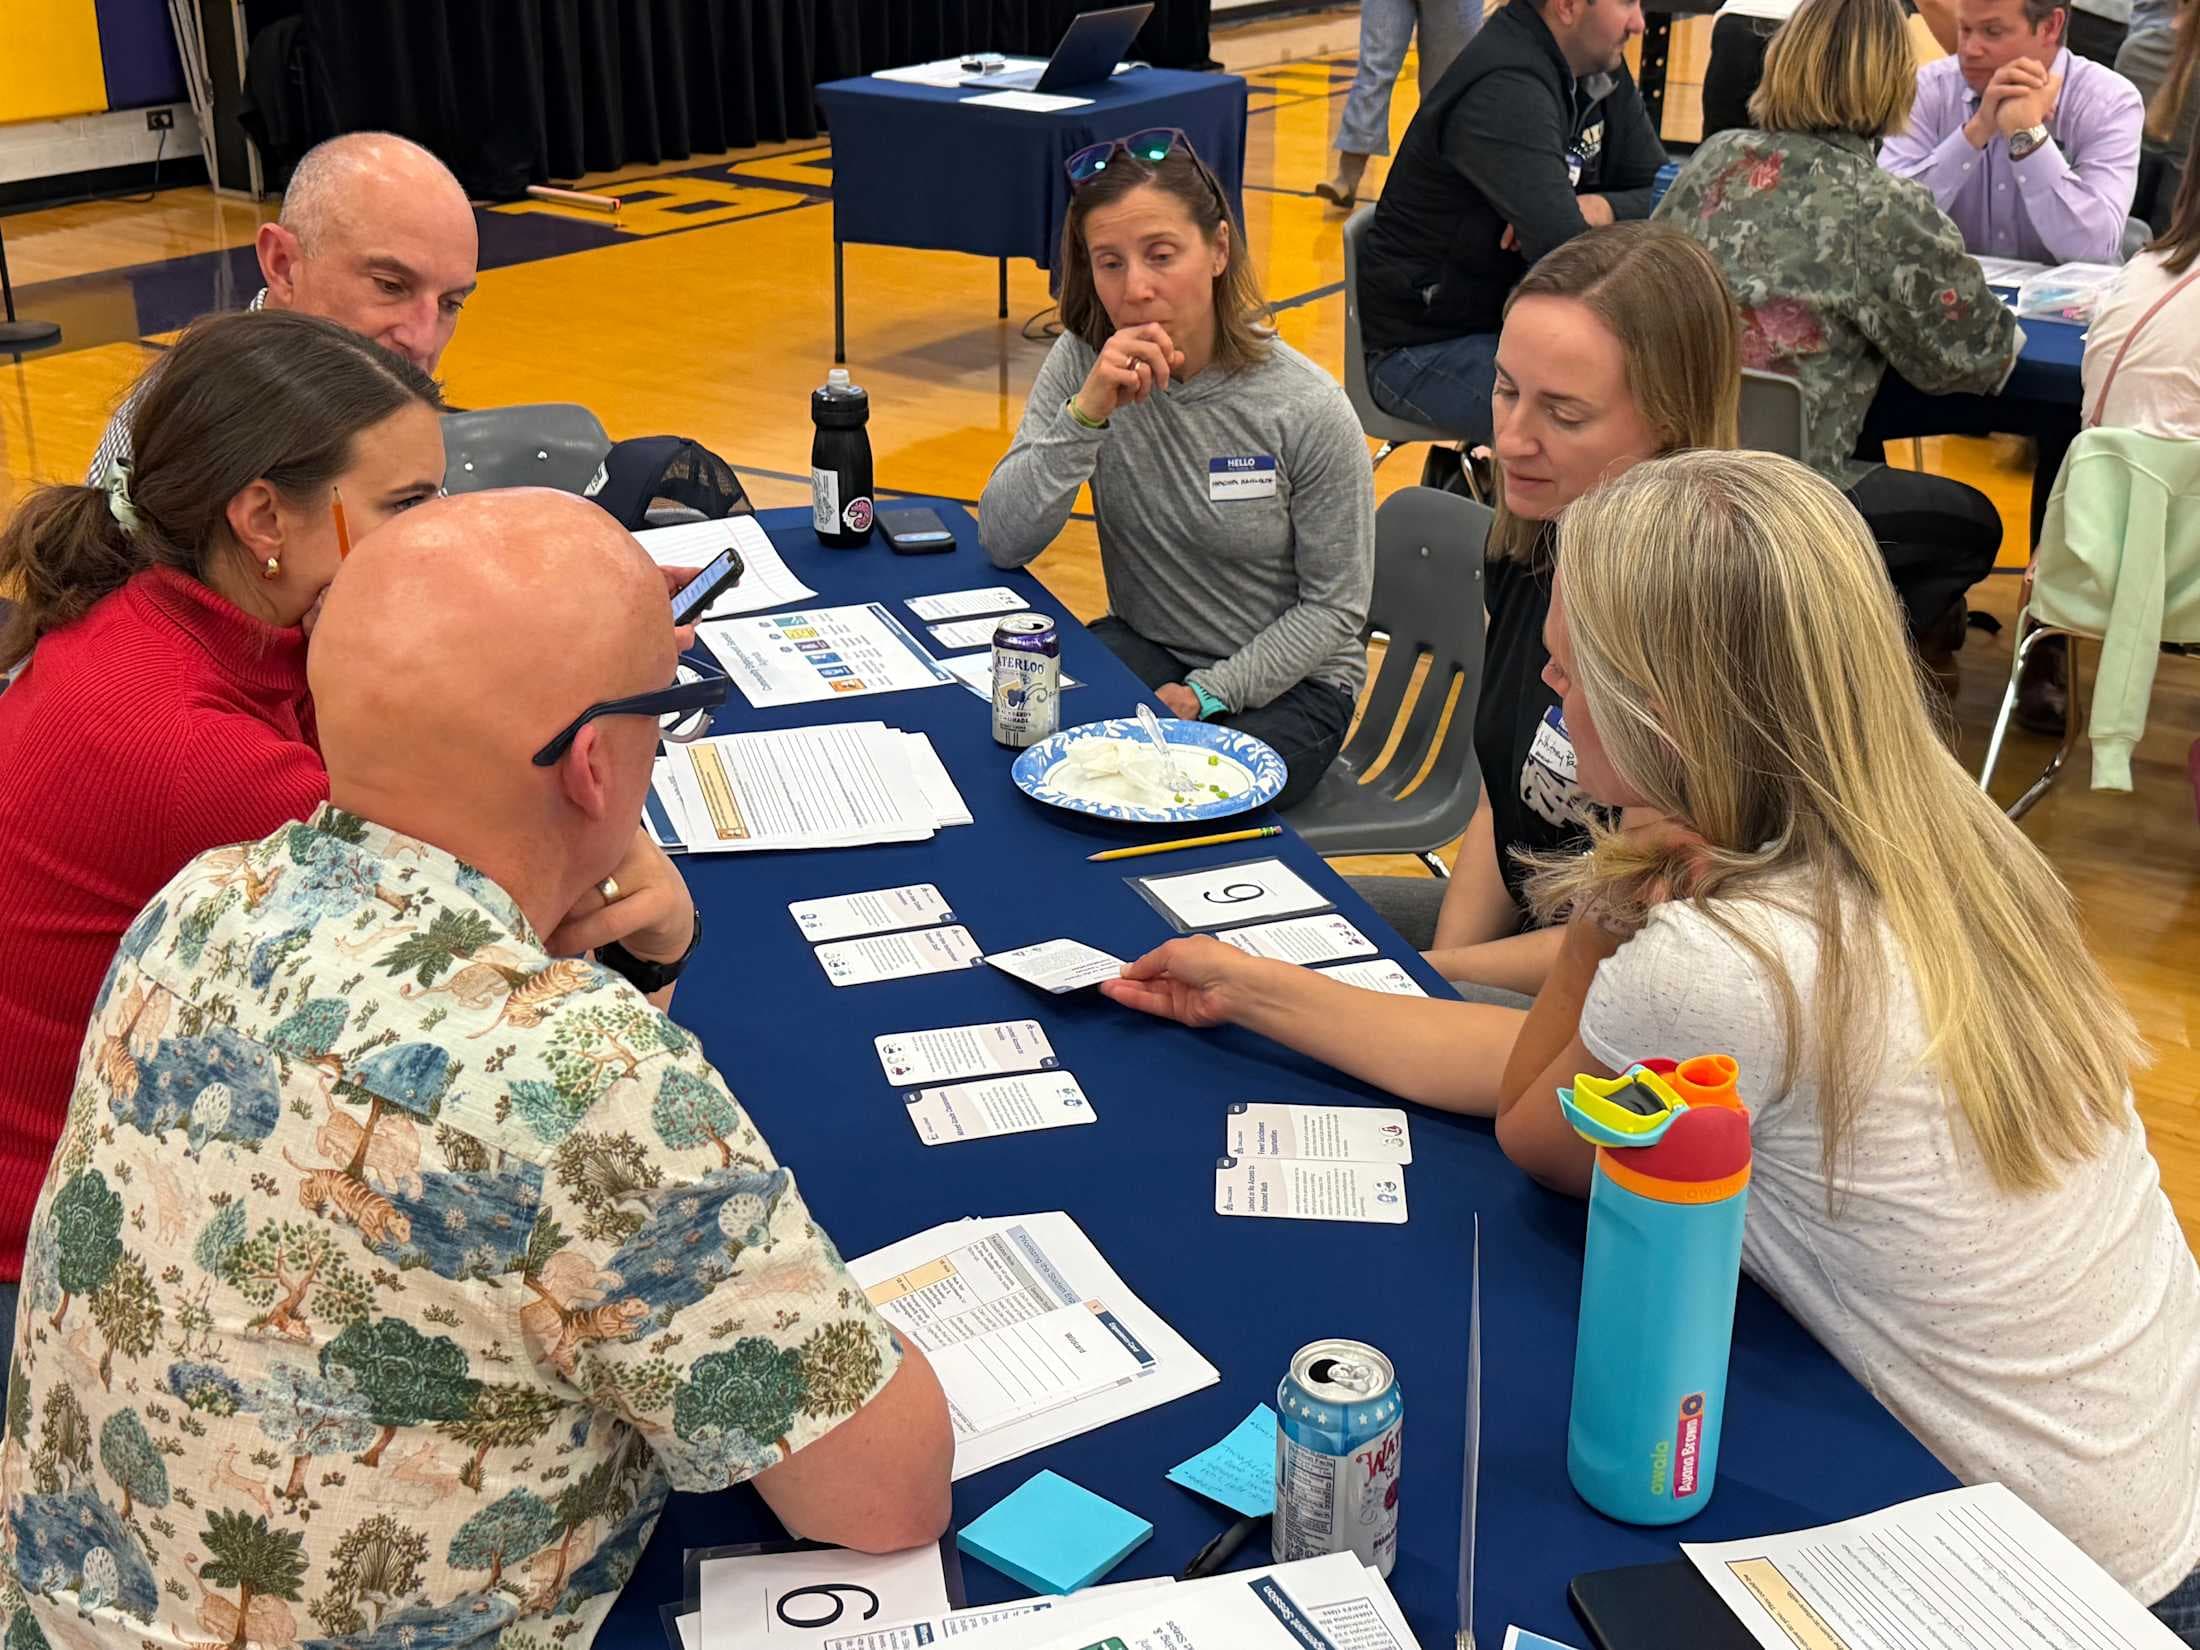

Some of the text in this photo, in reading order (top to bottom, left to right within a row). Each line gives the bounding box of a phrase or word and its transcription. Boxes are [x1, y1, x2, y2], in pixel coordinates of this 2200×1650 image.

[1227, 458, 1255, 467] HELLO
[1247, 1170, 1255, 1184] Access
[1260, 1182, 1268, 1212] Advanced Math
[1048, 1272, 1066, 1294] Student
[1064, 1331, 1087, 1354] Wildcard
[1651, 1440, 1669, 1495] owala
[1678, 1457, 1695, 1492] Ayana
[1263, 1585, 1295, 1620] Session
